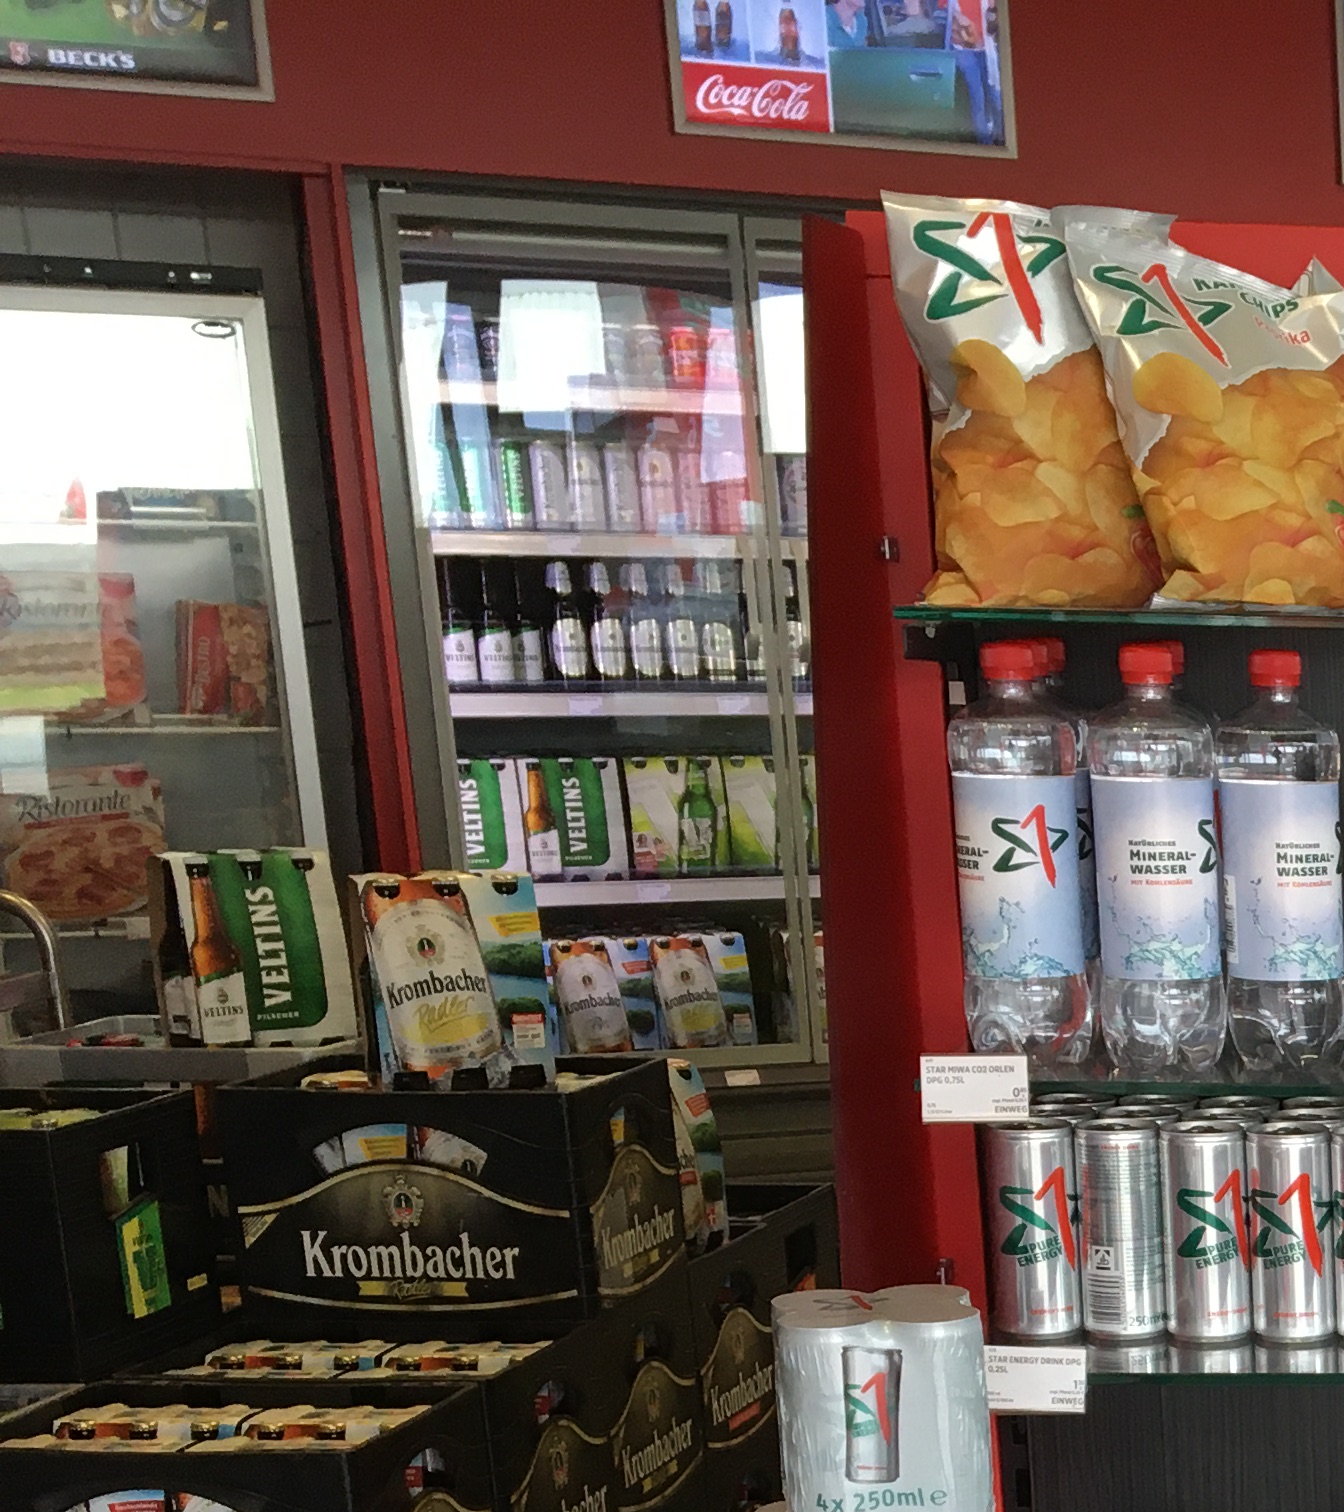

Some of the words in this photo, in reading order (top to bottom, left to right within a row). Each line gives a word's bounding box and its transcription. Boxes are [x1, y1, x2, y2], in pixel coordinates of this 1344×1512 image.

[47, 48, 137, 70] BECK'S
[1240, 287, 1300, 320] CHIPS
[15, 789, 132, 823] Ristorante
[562, 776, 588, 854] VELTINS
[461, 777, 485, 857] VELTINS
[1129, 849, 1197, 863] MINERAL-
[1276, 851, 1335, 865] MINERAL-
[1129, 862, 1188, 875] WASSER
[1276, 865, 1329, 877] WASSER
[244, 885, 293, 1009] VELTINS
[386, 968, 488, 1010] Krombacher
[203, 1003, 245, 1018] VELTINS
[989, 1065, 1014, 1073] ORLEN
[994, 1105, 1027, 1113] EINWEG
[1028, 1236, 1061, 1255] PURE
[1207, 1237, 1238, 1255] PURE
[1272, 1241, 1304, 1258] PURE
[300, 1230, 520, 1281] Krombacher
[1017, 1247, 1063, 1268] ENERGY
[1195, 1248, 1240, 1269] ENERGY
[1262, 1251, 1306, 1270] ENERGY
[1009, 1356, 1039, 1365] ENERGY
[622, 1418, 694, 1488] Krombacher
